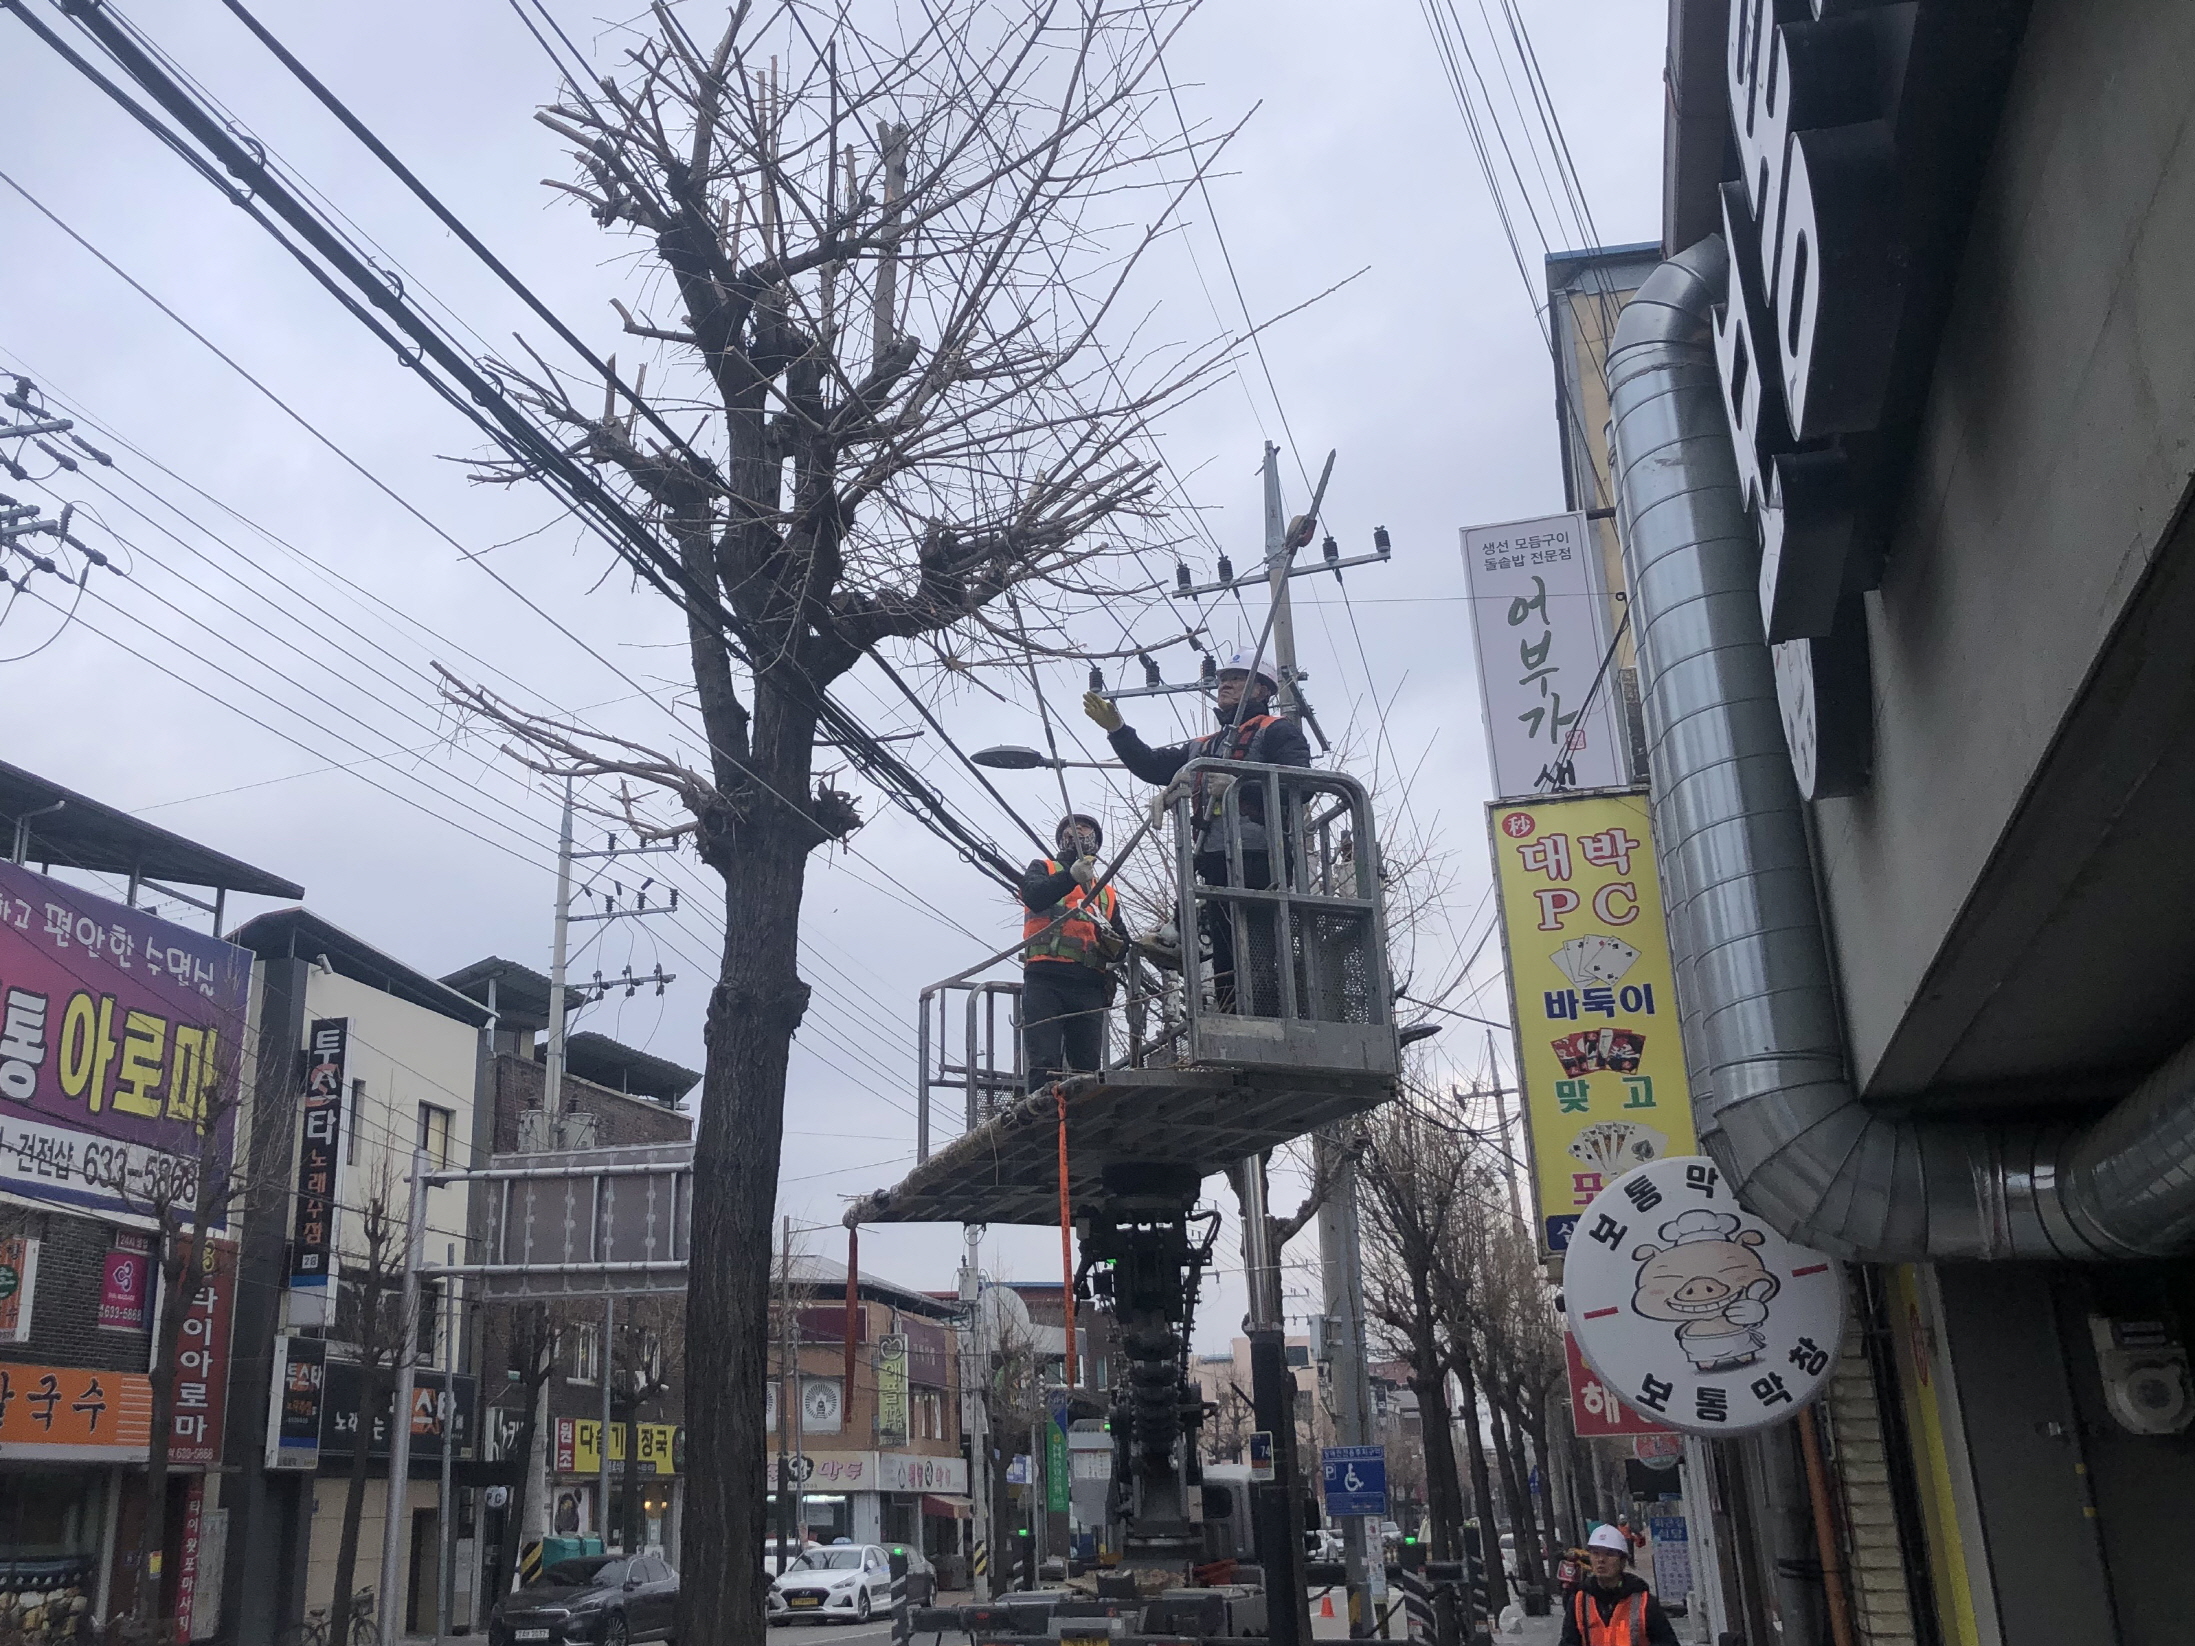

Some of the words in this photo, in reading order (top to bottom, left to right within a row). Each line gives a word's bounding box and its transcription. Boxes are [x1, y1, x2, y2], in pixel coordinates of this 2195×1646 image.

[1482, 540, 1509, 556] 생선
[1515, 531, 1569, 549] 모듬구이
[1531, 547, 1571, 565] 전문점
[1507, 575, 1578, 744] 어부가
[1517, 828, 1641, 881] 대박
[1533, 883, 1640, 931] PC
[44, 902, 134, 968] 편안한
[1543, 983, 1656, 1021] 바둑이
[59, 992, 219, 1136] 아로마
[306, 1029, 340, 1146] 투스타
[1556, 1075, 1656, 1114] 맞고
[84, 1141, 198, 1203] 633-5868
[1572, 1172, 1604, 1205] 포
[1588, 1164, 1719, 1251] 보통막
[1635, 1336, 1829, 1423] 보통막창
[558, 1421, 573, 1469] 원조
[1325, 1466, 1334, 1479] P
